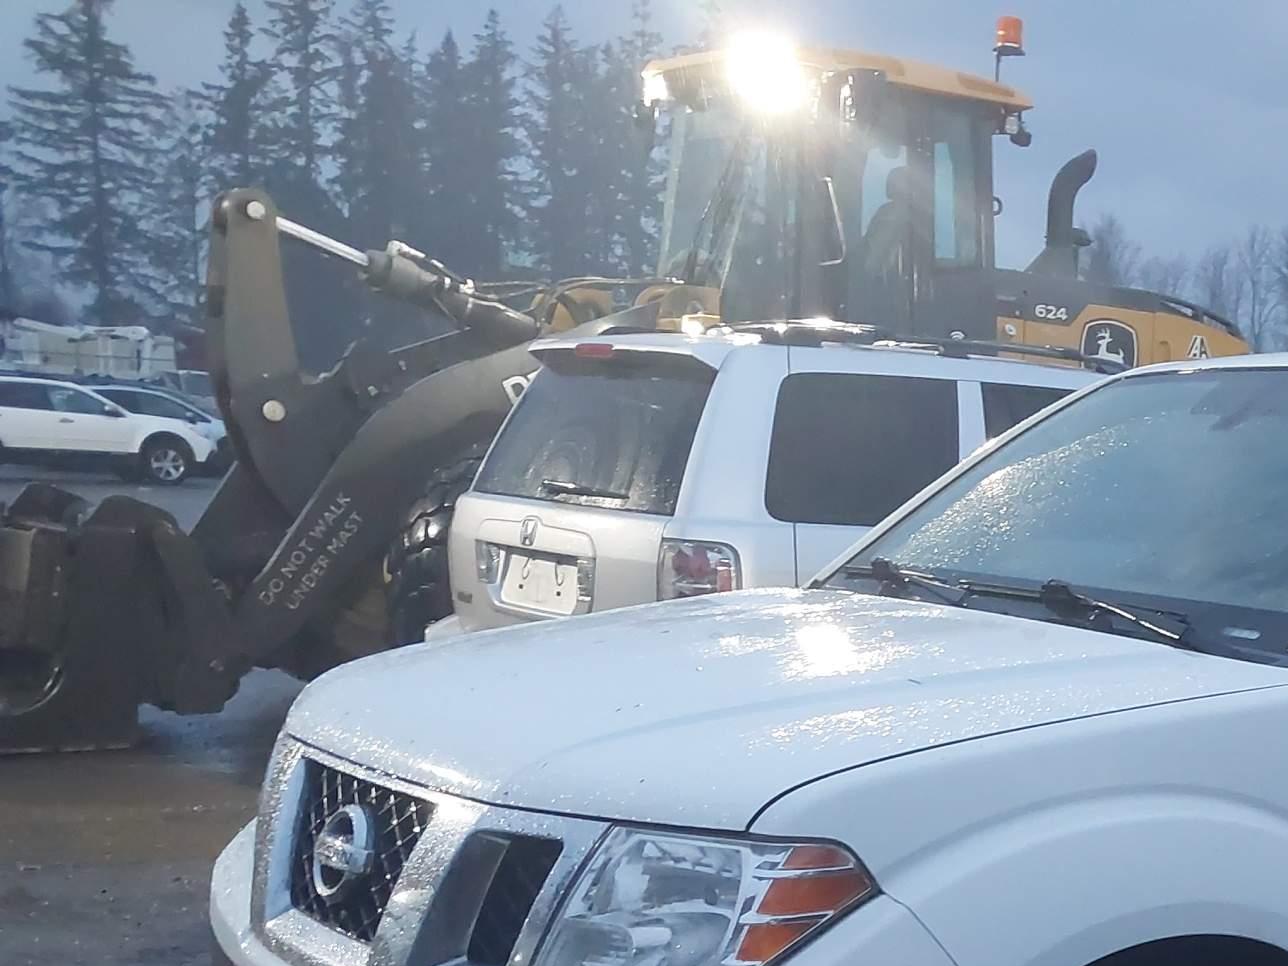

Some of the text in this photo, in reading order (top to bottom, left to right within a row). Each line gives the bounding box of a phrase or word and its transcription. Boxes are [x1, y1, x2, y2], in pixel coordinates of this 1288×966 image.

[1034, 303, 1068, 321] 624
[259, 491, 351, 605] DO NOT WALK
[286, 511, 362, 609] UNDER MAST
